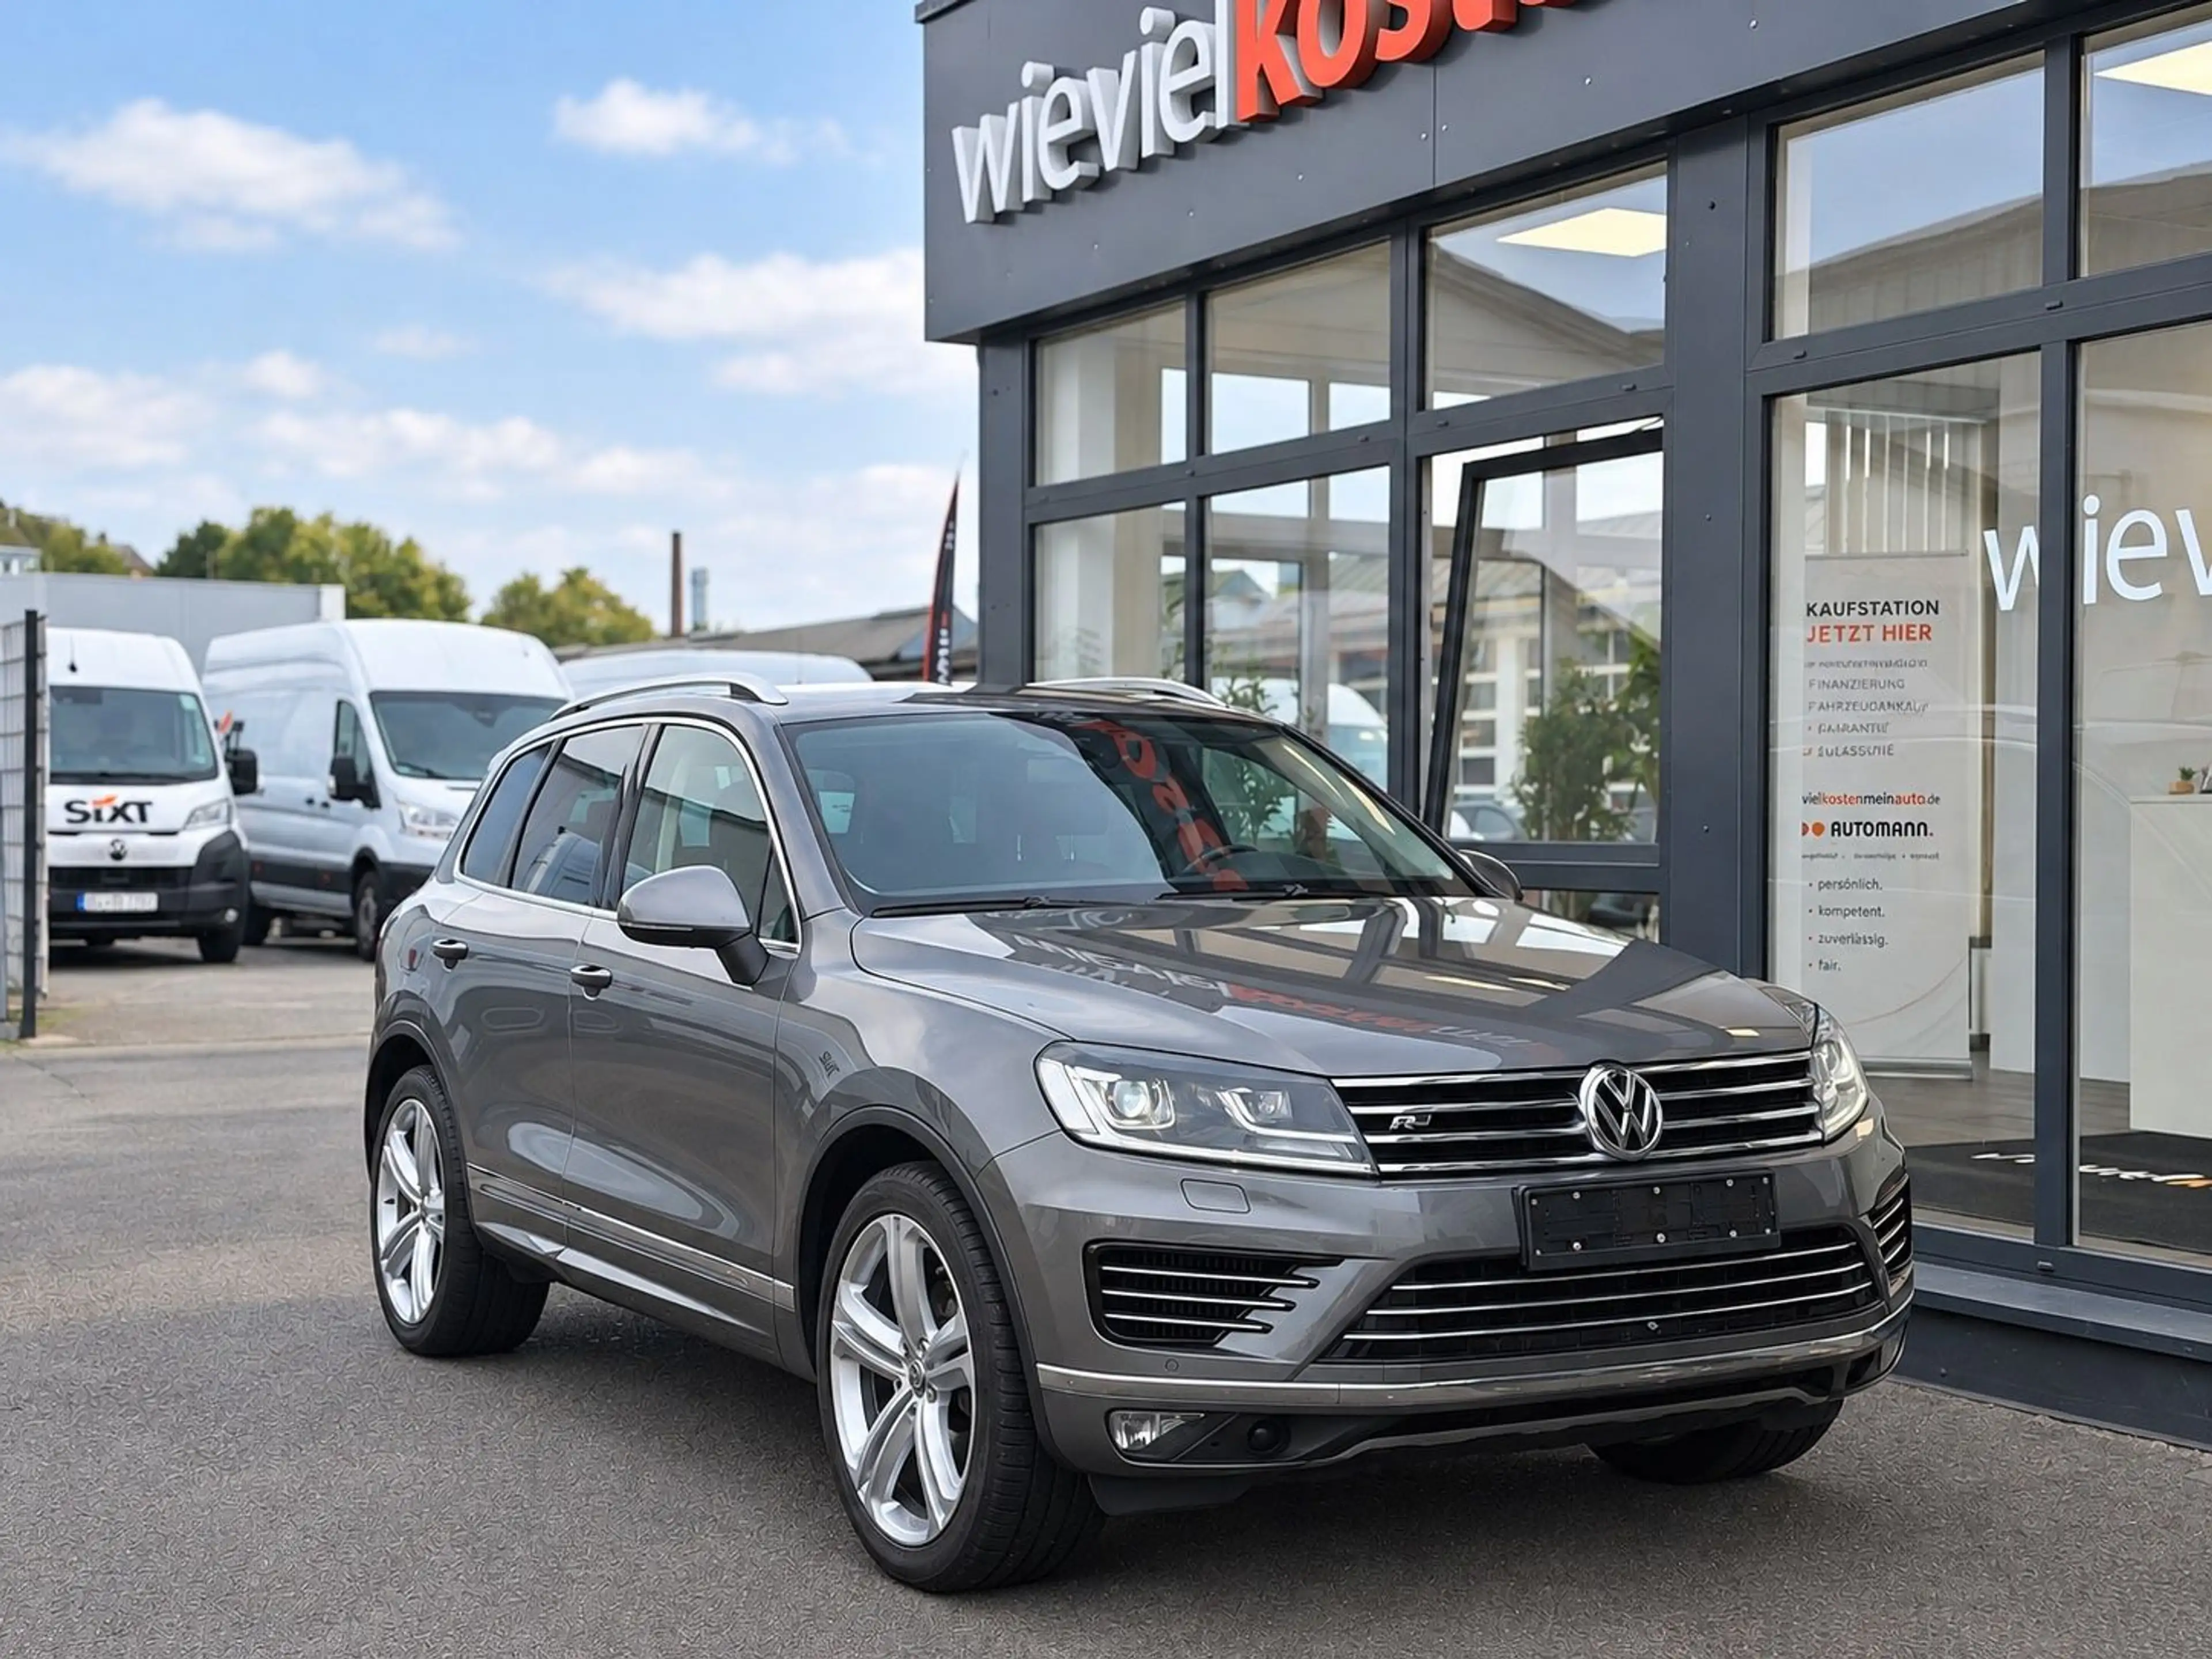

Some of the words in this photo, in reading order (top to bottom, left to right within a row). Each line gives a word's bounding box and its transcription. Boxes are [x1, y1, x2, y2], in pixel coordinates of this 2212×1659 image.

[1806, 600, 1940, 617] KAUFSTATION
[1806, 624, 1875, 643] JETZT
[1882, 624, 1932, 642] HIER
[1819, 905, 1885, 919] kompetent.
[1818, 932, 1889, 948] zuverlässig.
[1819, 959, 1841, 971] fair.
